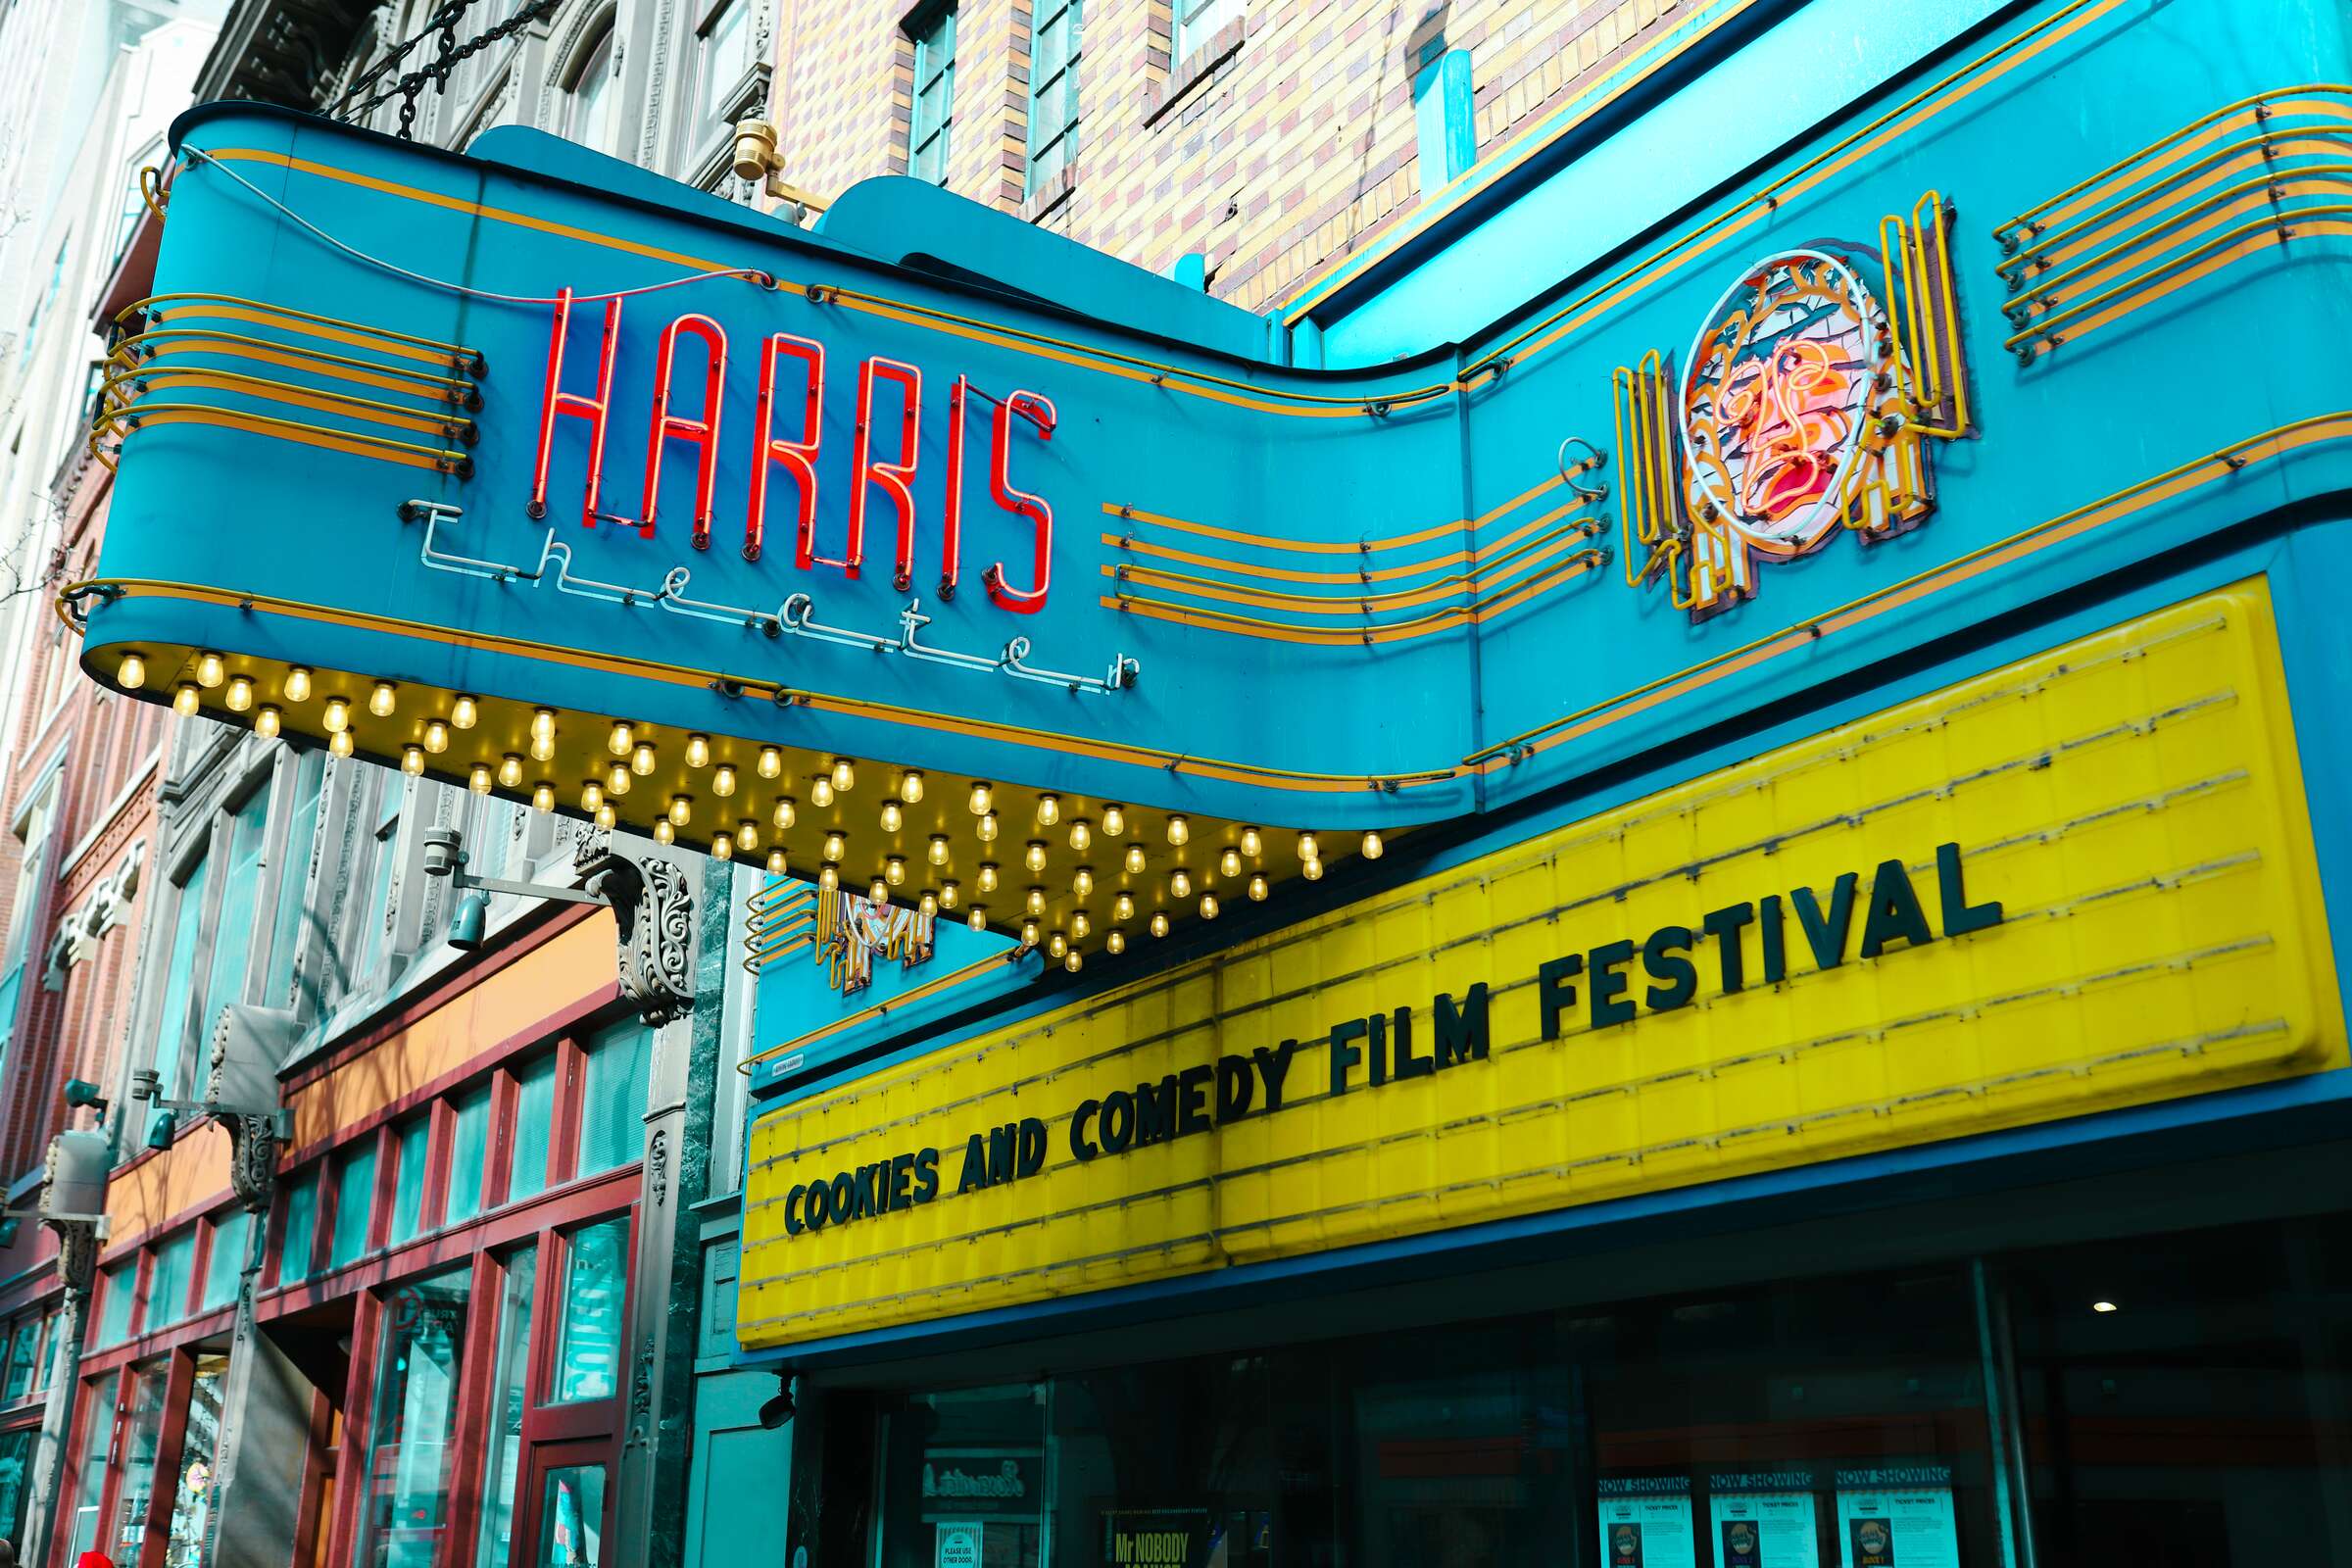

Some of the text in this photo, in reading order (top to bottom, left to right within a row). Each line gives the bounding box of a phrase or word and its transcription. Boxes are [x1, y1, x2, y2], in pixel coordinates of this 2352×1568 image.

[526, 286, 1058, 615] HARRIS
[398, 498, 1141, 696] Theater
[784, 842, 2003, 1236] COOKIES AND COMEDY FILM FESTIVAL
[1598, 1476, 1691, 1492] NOW SHOWING
[1710, 1472, 1812, 1489] NOW SHOWING
[1836, 1467, 1951, 1485] NOW SHOWING
[1115, 1534, 1135, 1563] Mr
[1135, 1532, 1190, 1563] NOBODY
